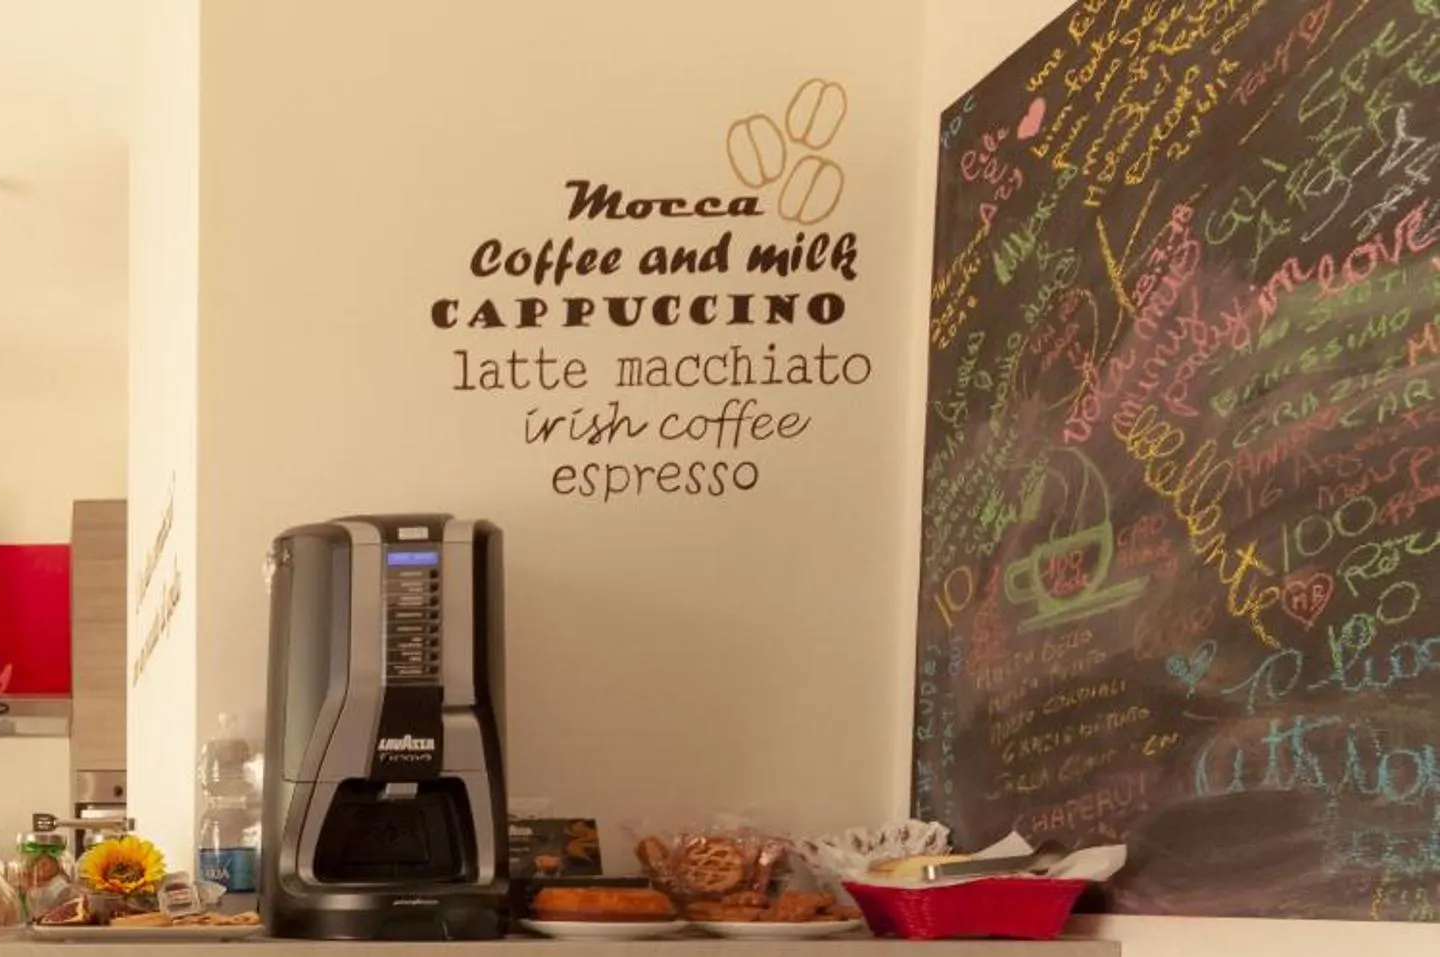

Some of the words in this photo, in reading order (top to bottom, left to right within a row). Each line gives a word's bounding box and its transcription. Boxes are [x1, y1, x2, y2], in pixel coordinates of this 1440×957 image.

[565, 180, 765, 221] Mocca
[470, 237, 623, 286] Coffee
[638, 230, 733, 276] and
[746, 231, 858, 282] milk
[430, 293, 846, 329] CAPPUCCINO
[452, 346, 589, 391] latte
[615, 343, 872, 388] macchiato
[524, 400, 649, 446] irish
[658, 397, 811, 449] coffee
[551, 460, 759, 503] espresso
